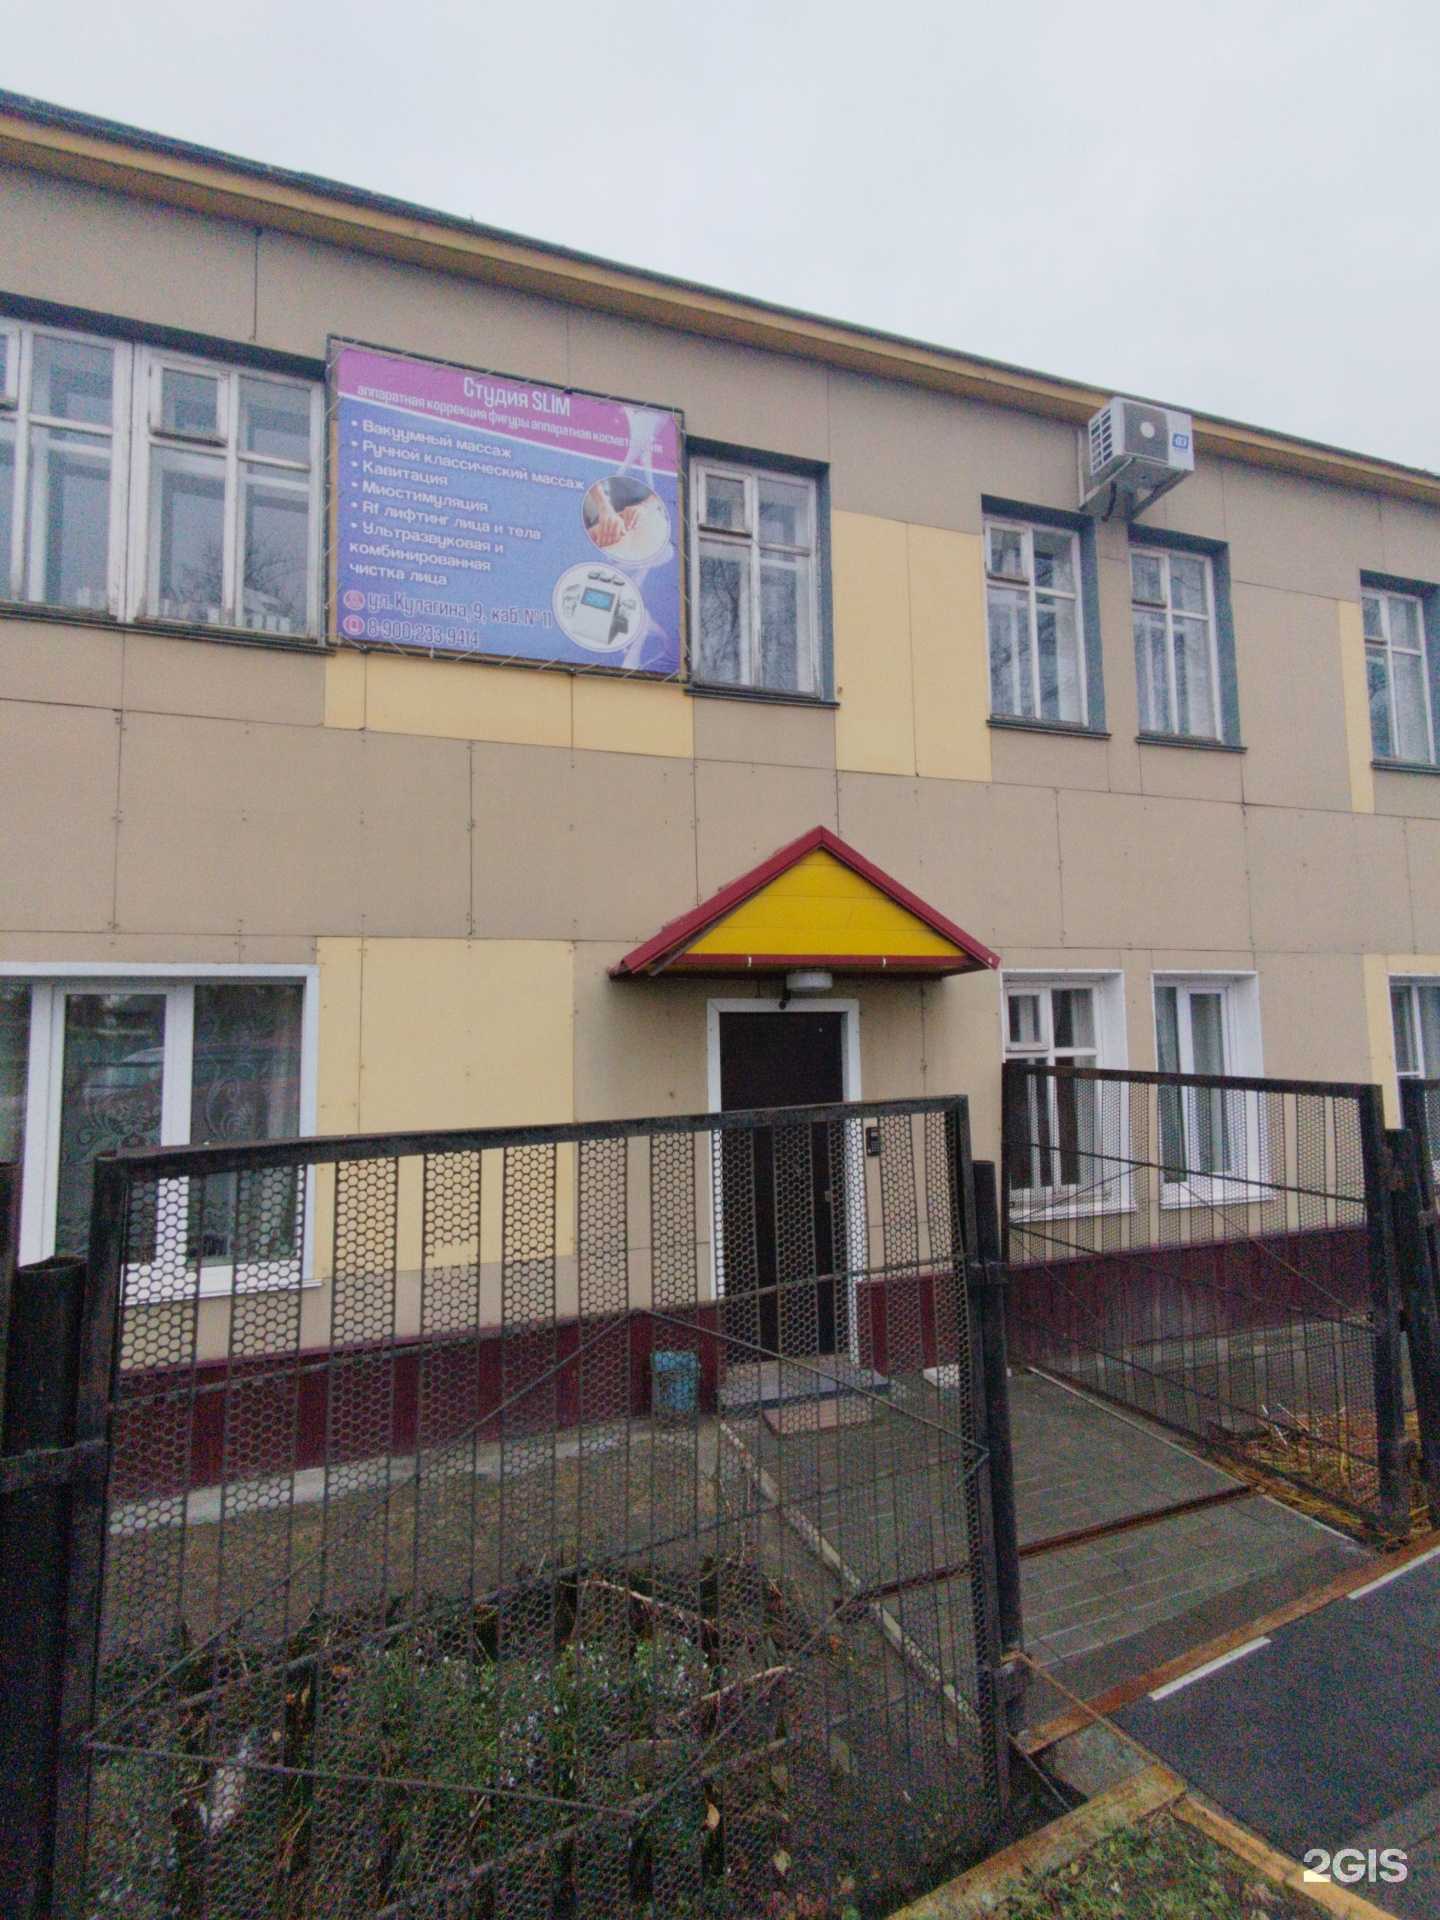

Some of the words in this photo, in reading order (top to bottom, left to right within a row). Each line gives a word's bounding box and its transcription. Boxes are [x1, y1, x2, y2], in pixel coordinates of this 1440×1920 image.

[357, 385, 425, 409] аппаратная
[427, 399, 487, 420] коррекция
[488, 410, 530, 430] фигуры
[463, 376, 529, 407] Студия
[531, 391, 571, 417] SLIM
[362, 419, 453, 448] Вакуумный
[456, 439, 512, 459] массаж
[362, 439, 421, 462] Ручной
[423, 453, 529, 481] классический
[531, 472, 585, 490] массаж
[362, 459, 449, 486] Кавитация
[362, 479, 489, 513] Миостимуляция
[362, 521, 491, 553] Ультразвуковая
[494, 543, 504, 554] и
[383, 506, 449, 526] лифтинг
[454, 518, 491, 533] лица
[494, 524, 504, 534] и
[507, 526, 542, 541] тела
[349, 542, 491, 572] комбинированная
[349, 563, 405, 580] чистка
[410, 571, 448, 586] лица
